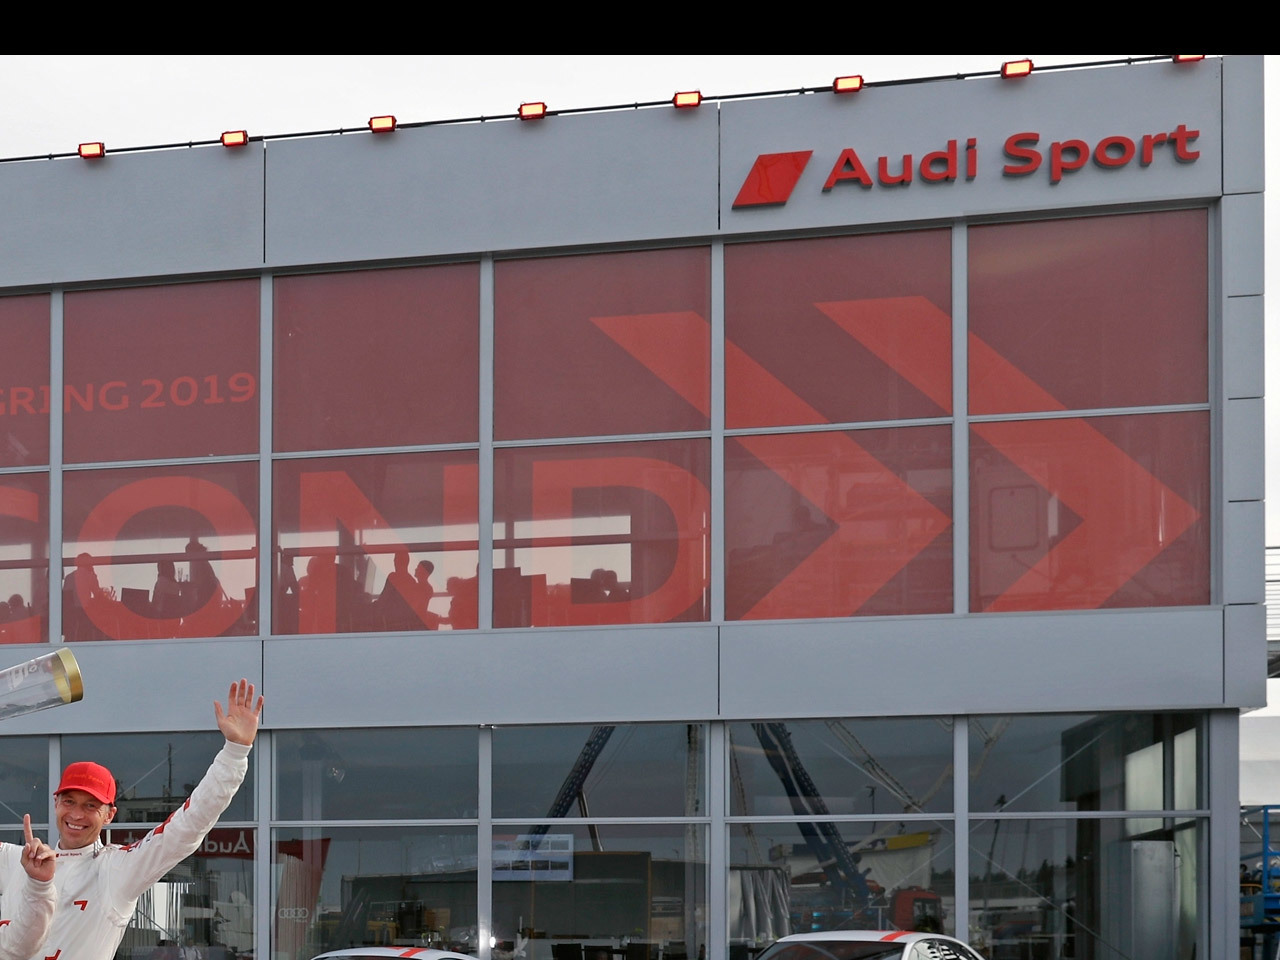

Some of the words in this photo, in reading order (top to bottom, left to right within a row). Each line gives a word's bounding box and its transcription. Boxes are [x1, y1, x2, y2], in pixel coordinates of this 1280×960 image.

[822, 138, 977, 192] Audi
[1003, 124, 1200, 184] Sport
[140, 371, 257, 410] 2019
